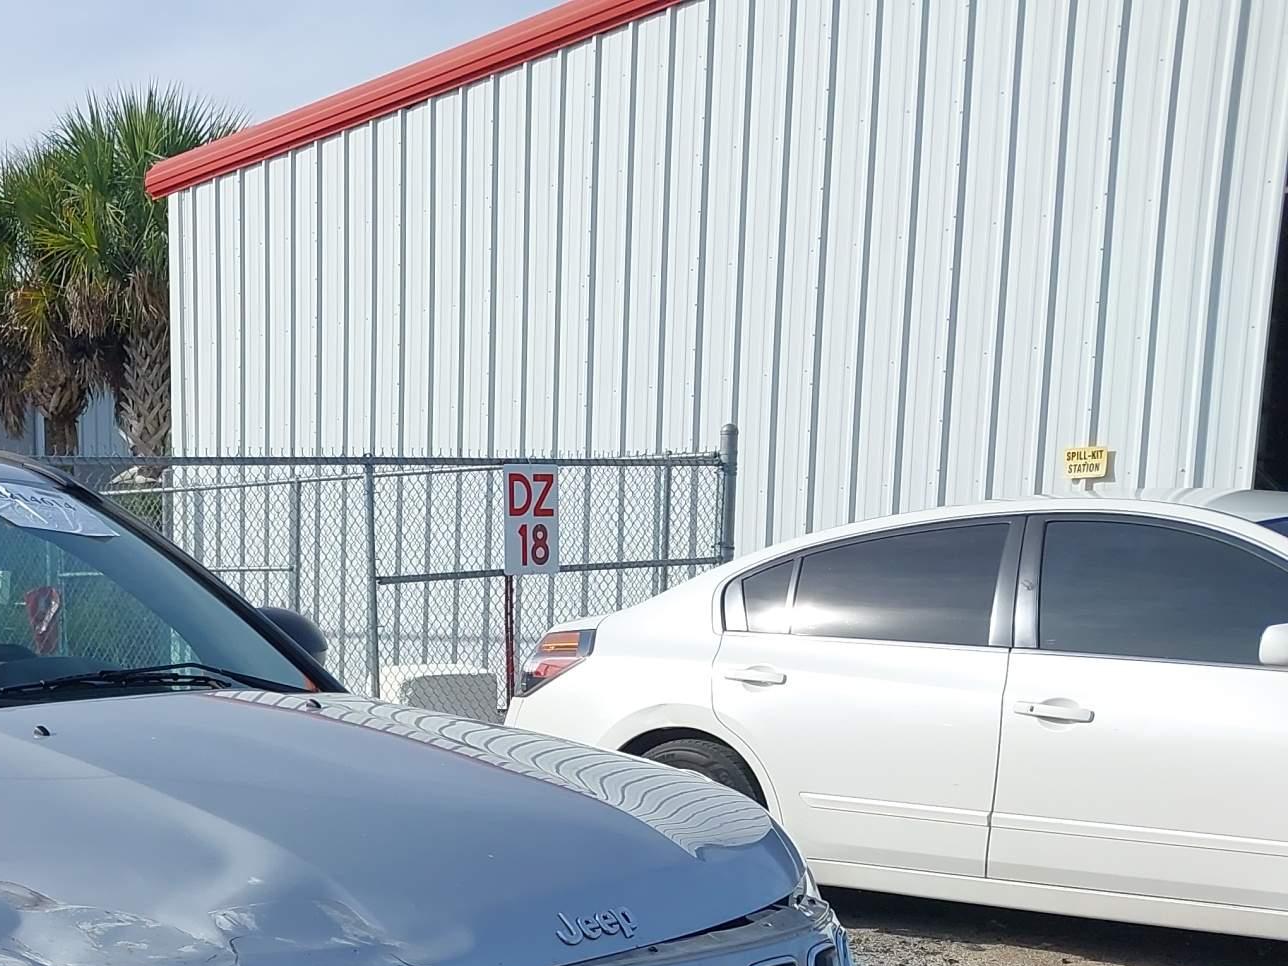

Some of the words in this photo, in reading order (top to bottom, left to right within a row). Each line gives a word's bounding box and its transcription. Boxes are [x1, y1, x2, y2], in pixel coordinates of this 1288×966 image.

[1066, 449, 1104, 461] SPILL-KIT
[1067, 462, 1101, 474] STATION
[508, 472, 554, 517] DZ
[518, 523, 550, 566] 18
[555, 906, 638, 946] Jeep
